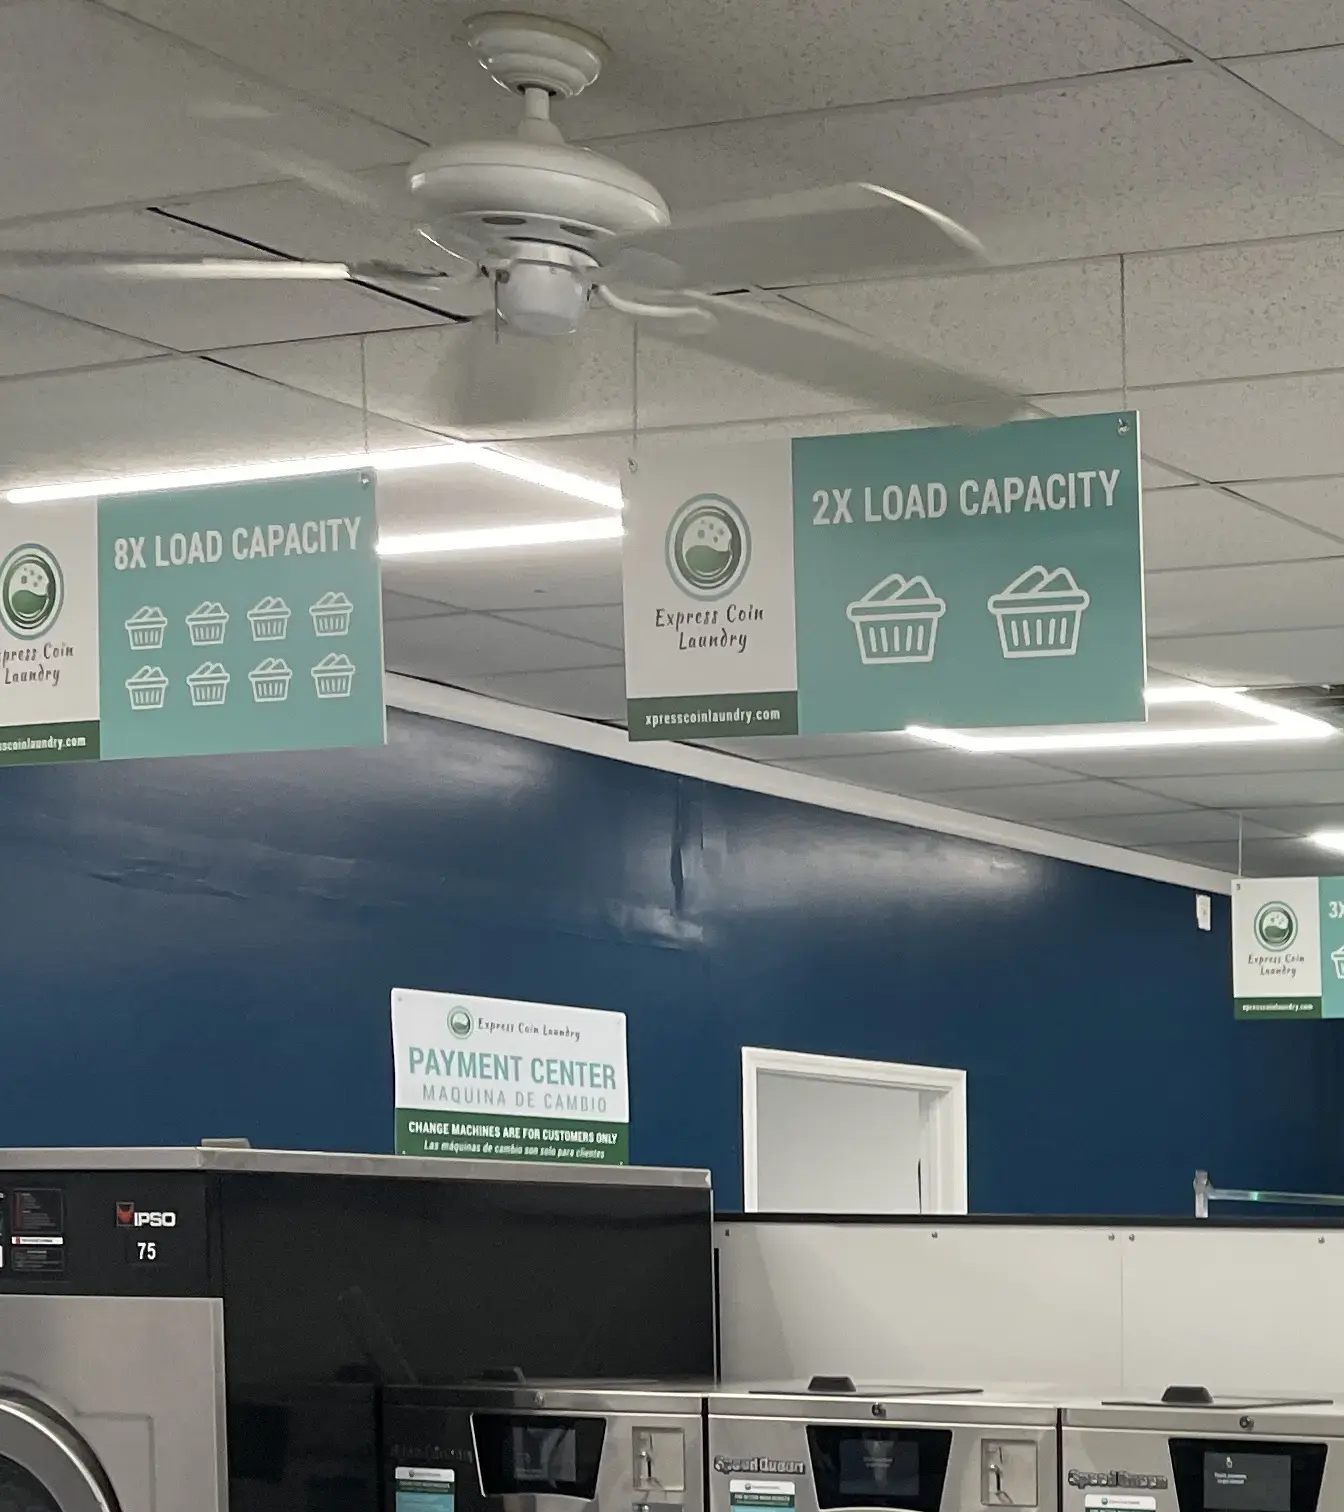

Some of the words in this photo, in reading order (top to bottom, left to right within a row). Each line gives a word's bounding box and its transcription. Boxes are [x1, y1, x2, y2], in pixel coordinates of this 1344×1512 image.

[812, 488, 854, 525] 2X
[864, 481, 948, 523] LOAD
[959, 468, 1121, 516] CAPACITY
[113, 536, 147, 571] 8X
[155, 529, 223, 567] LOAD
[231, 516, 362, 562] CAPACITY
[655, 605, 720, 632] Express
[726, 603, 764, 624] Coin
[678, 629, 748, 653] Laundry
[0, 641, 37, 667] press
[42, 642, 75, 660] Coin
[3, 664, 61, 687] Laundry
[645, 707, 781, 728] xpresscoinlaundry.com
[478, 1017, 515, 1032] Express
[518, 1021, 540, 1034] Coin
[542, 1023, 582, 1042] Laundry
[408, 1046, 523, 1082] PAYMENT
[530, 1057, 617, 1090] CENTER
[422, 1083, 506, 1107] MAQUINA
[515, 1091, 535, 1109] DE
[543, 1092, 608, 1114] CAMBIO
[408, 1121, 450, 1136] CHANGE
[451, 1123, 501, 1139] MACHINES
[503, 1126, 521, 1140] ARE
[522, 1128, 541, 1141] FOR
[542, 1129, 595, 1144] CUSTOMERS
[596, 1132, 618, 1145] ONLY
[423, 1139, 439, 1151] Las
[134, 1212, 177, 1227] IPSO
[137, 1242, 157, 1260] 75
